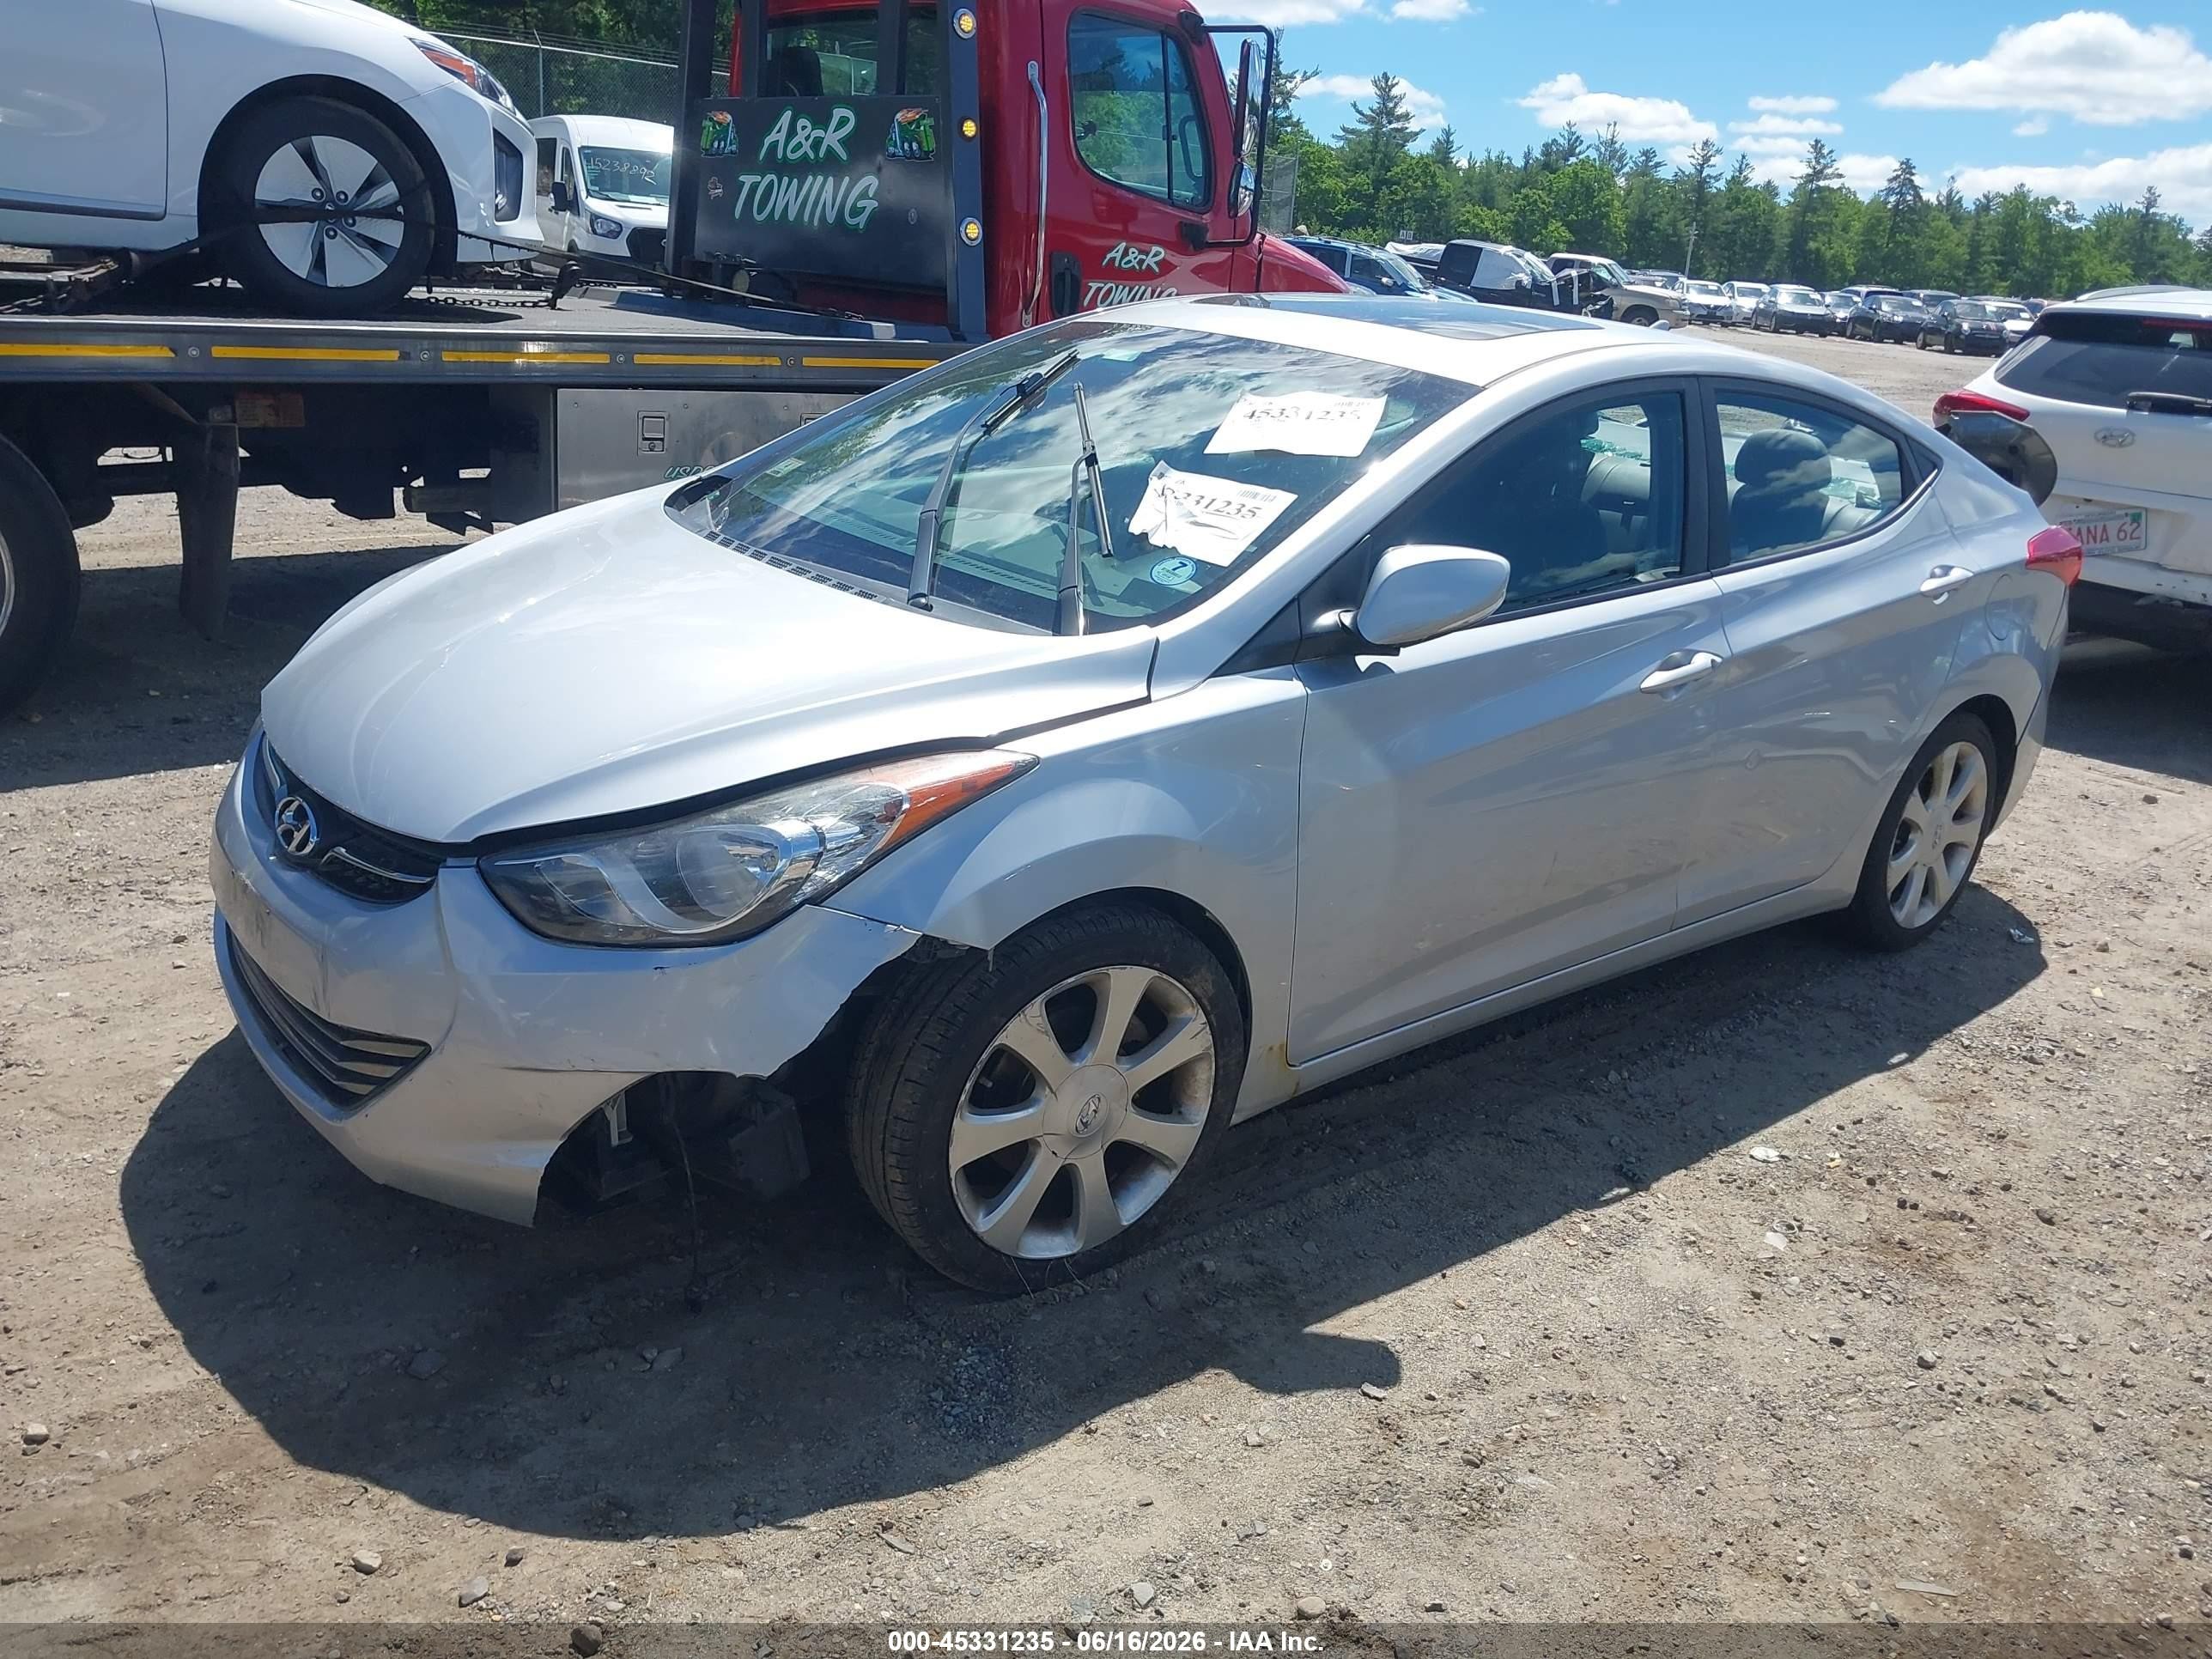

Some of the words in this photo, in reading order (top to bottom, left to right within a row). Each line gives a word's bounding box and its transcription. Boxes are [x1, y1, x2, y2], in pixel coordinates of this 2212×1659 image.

[759, 107, 855, 161] A&R
[734, 174, 878, 228] TOWING
[1102, 242, 1165, 273] A&R
[665, 465, 716, 479] USD
[2067, 523, 2110, 545] ANA
[2116, 521, 2142, 541] 62
[1171, 561, 1188, 571] 7
